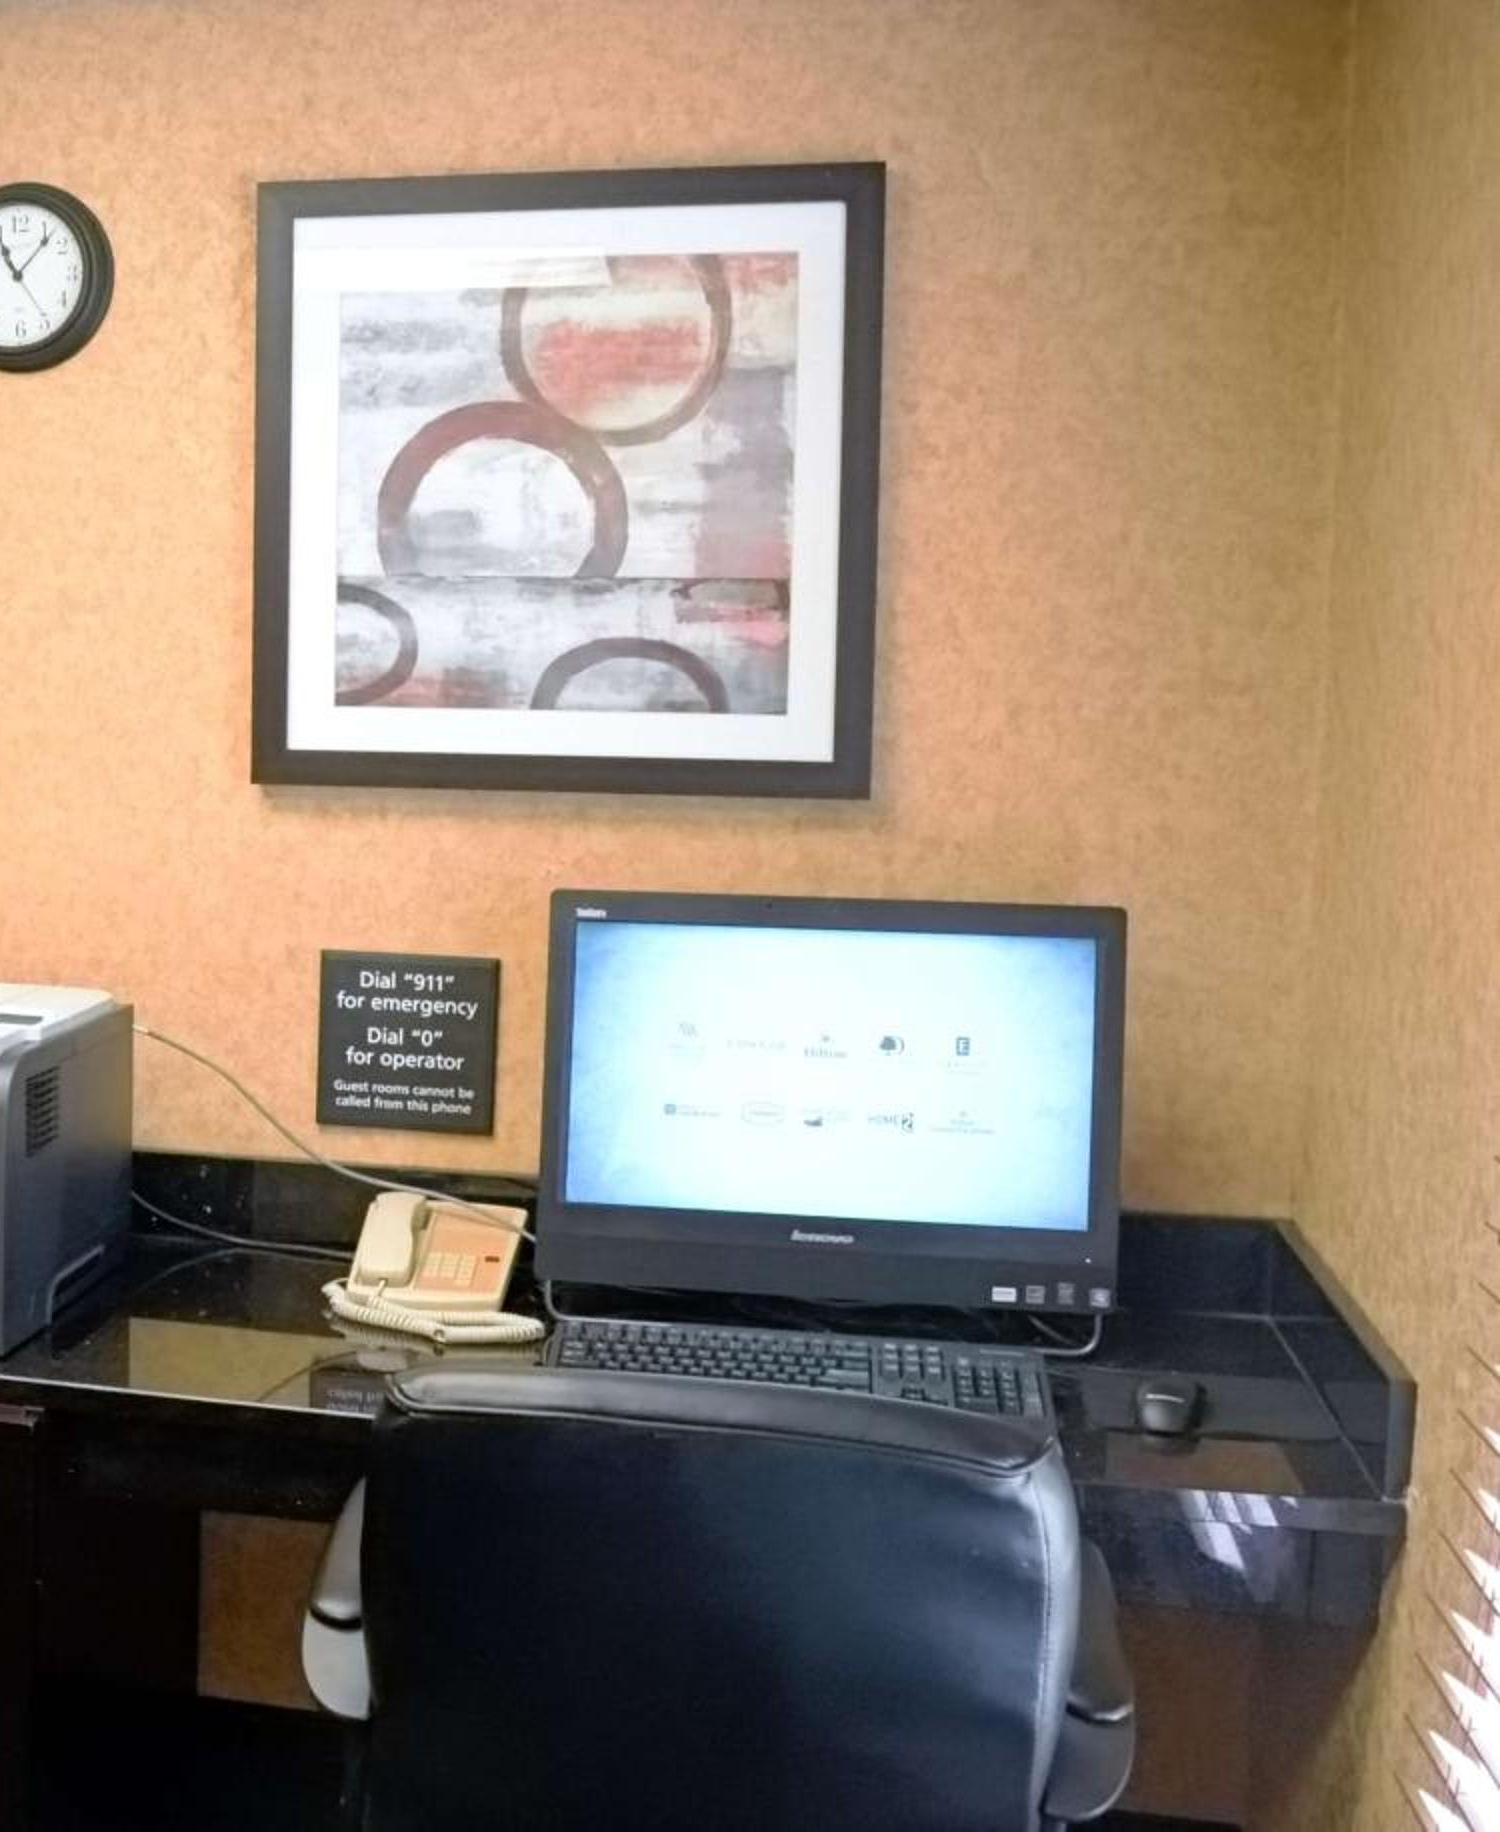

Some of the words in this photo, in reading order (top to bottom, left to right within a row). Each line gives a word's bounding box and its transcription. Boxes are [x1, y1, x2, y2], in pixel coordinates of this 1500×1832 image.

[12, 214, 30, 233] 12
[56, 237, 68, 255] 2
[14, 319, 28, 338] 6
[359, 970, 397, 989] Dial
[403, 973, 455, 992] "911"
[336, 990, 365, 1009] for
[370, 996, 478, 1020] emergency
[367, 1027, 404, 1045] Dial
[345, 1046, 374, 1065] for
[379, 1052, 465, 1071] operator
[333, 1079, 369, 1093] Guest
[372, 1082, 409, 1095] rooms
[412, 1085, 455, 1098] cannot
[458, 1087, 475, 1099] be
[335, 1096, 371, 1108] called
[374, 1096, 404, 1110] from
[407, 1099, 429, 1112] this
[431, 1101, 472, 1114] phone
